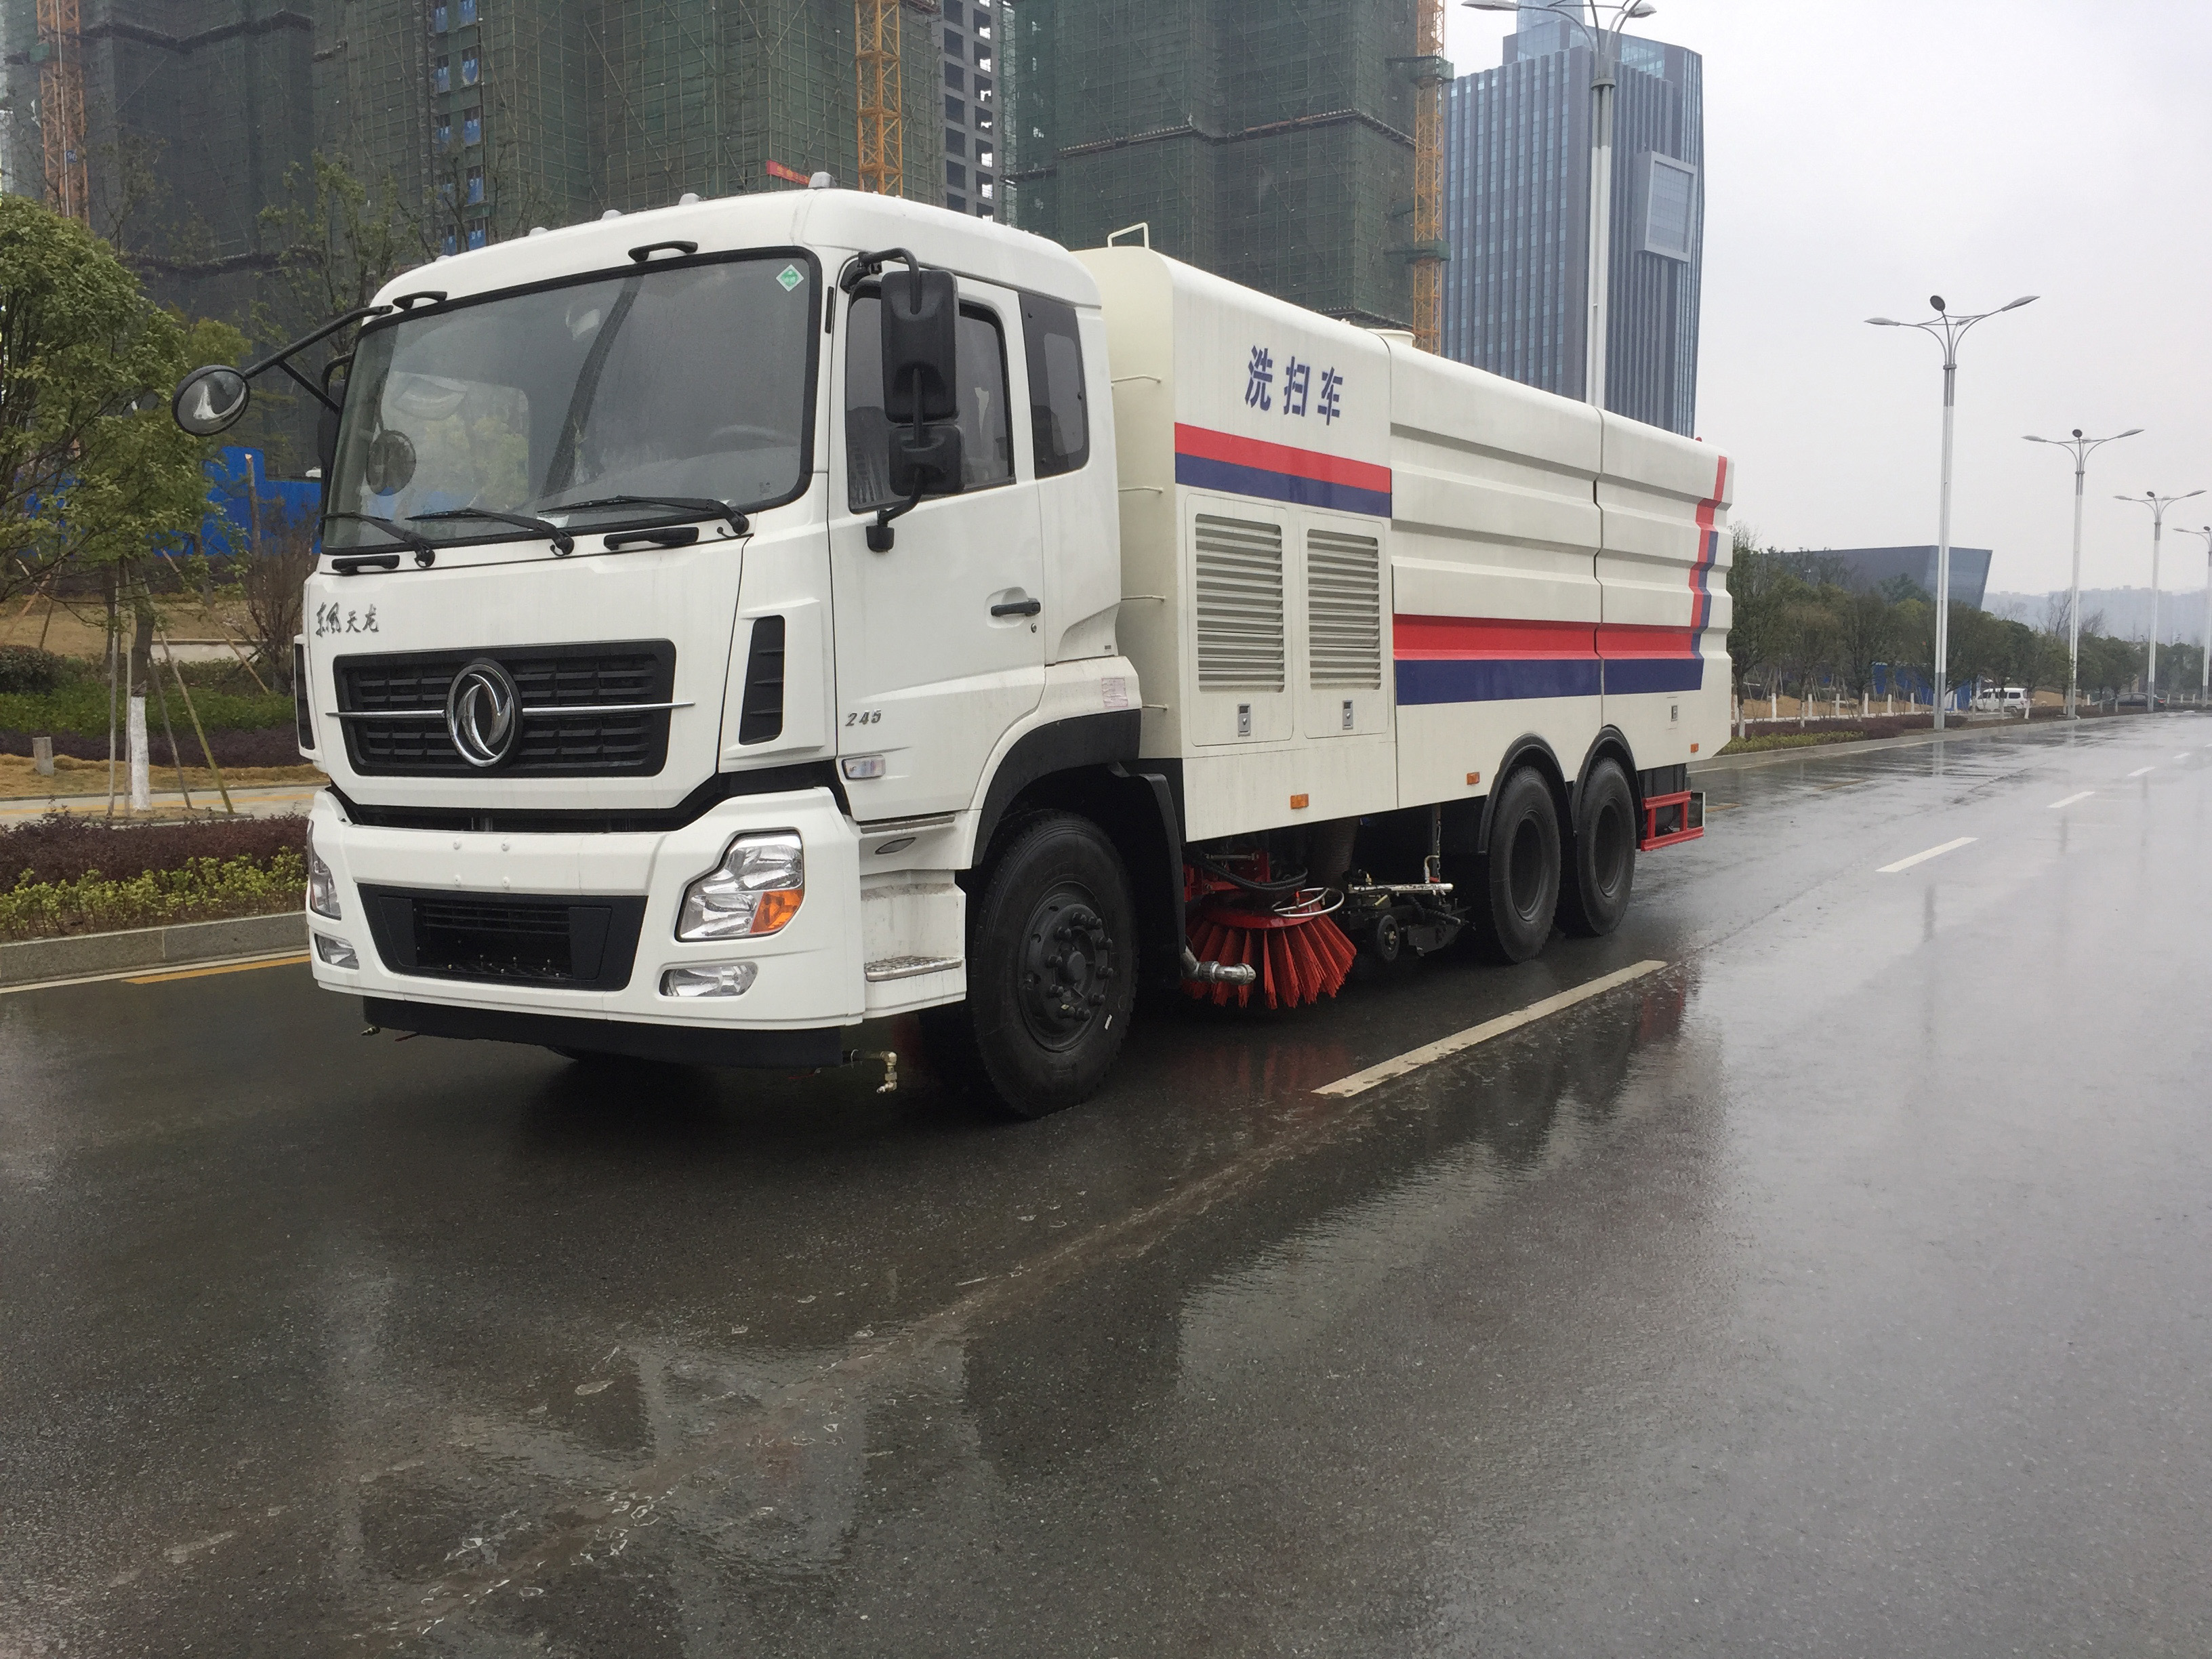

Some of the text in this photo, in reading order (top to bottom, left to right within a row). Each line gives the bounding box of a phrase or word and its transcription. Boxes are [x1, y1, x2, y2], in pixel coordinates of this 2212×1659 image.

[1244, 345, 1343, 426] 洗扫车
[845, 709, 882, 726] 245
